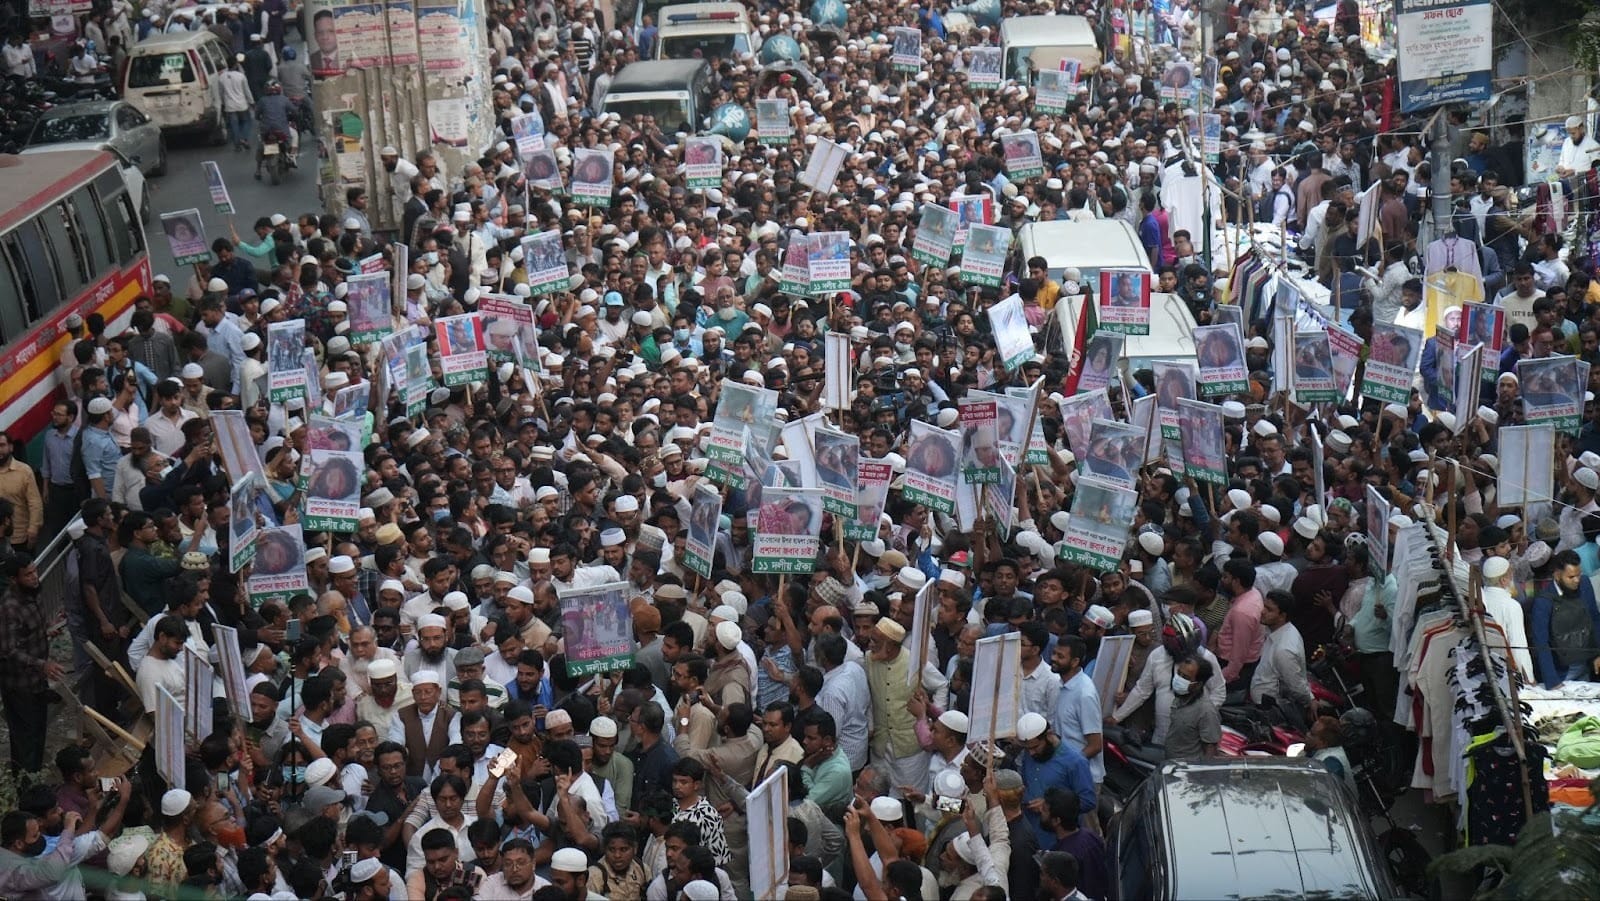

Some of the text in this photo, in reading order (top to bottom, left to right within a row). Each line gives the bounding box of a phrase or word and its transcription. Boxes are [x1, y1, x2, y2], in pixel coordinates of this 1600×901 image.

[1424, 8, 1463, 19] সফল হোক
[281, 391, 292, 399] দলীয়
[294, 389, 303, 397] ঐক্য
[1215, 383, 1230, 392] দলীয়
[1232, 382, 1245, 391] ঐক্য
[1363, 384, 1406, 402] ১১ দলীয় ঐক্য
[709, 450, 741, 464] ১১ দলীয়
[708, 470, 717, 478] ১১
[905, 490, 950, 512] ১১ দলীয় ঐক্য
[309, 518, 356, 532] ১১ দলীয় ঐক্য
[784, 547, 800, 555] জবাব
[1067, 536, 1087, 547] প্রশাসন
[1090, 542, 1106, 553] জবাব
[758, 558, 814, 572] ১১ দলীয় ঐক্য
[1064, 550, 1117, 572] ১১ দলীয় ঐক্য
[572, 658, 631, 676] ১১ দলীয় ঐক্য
